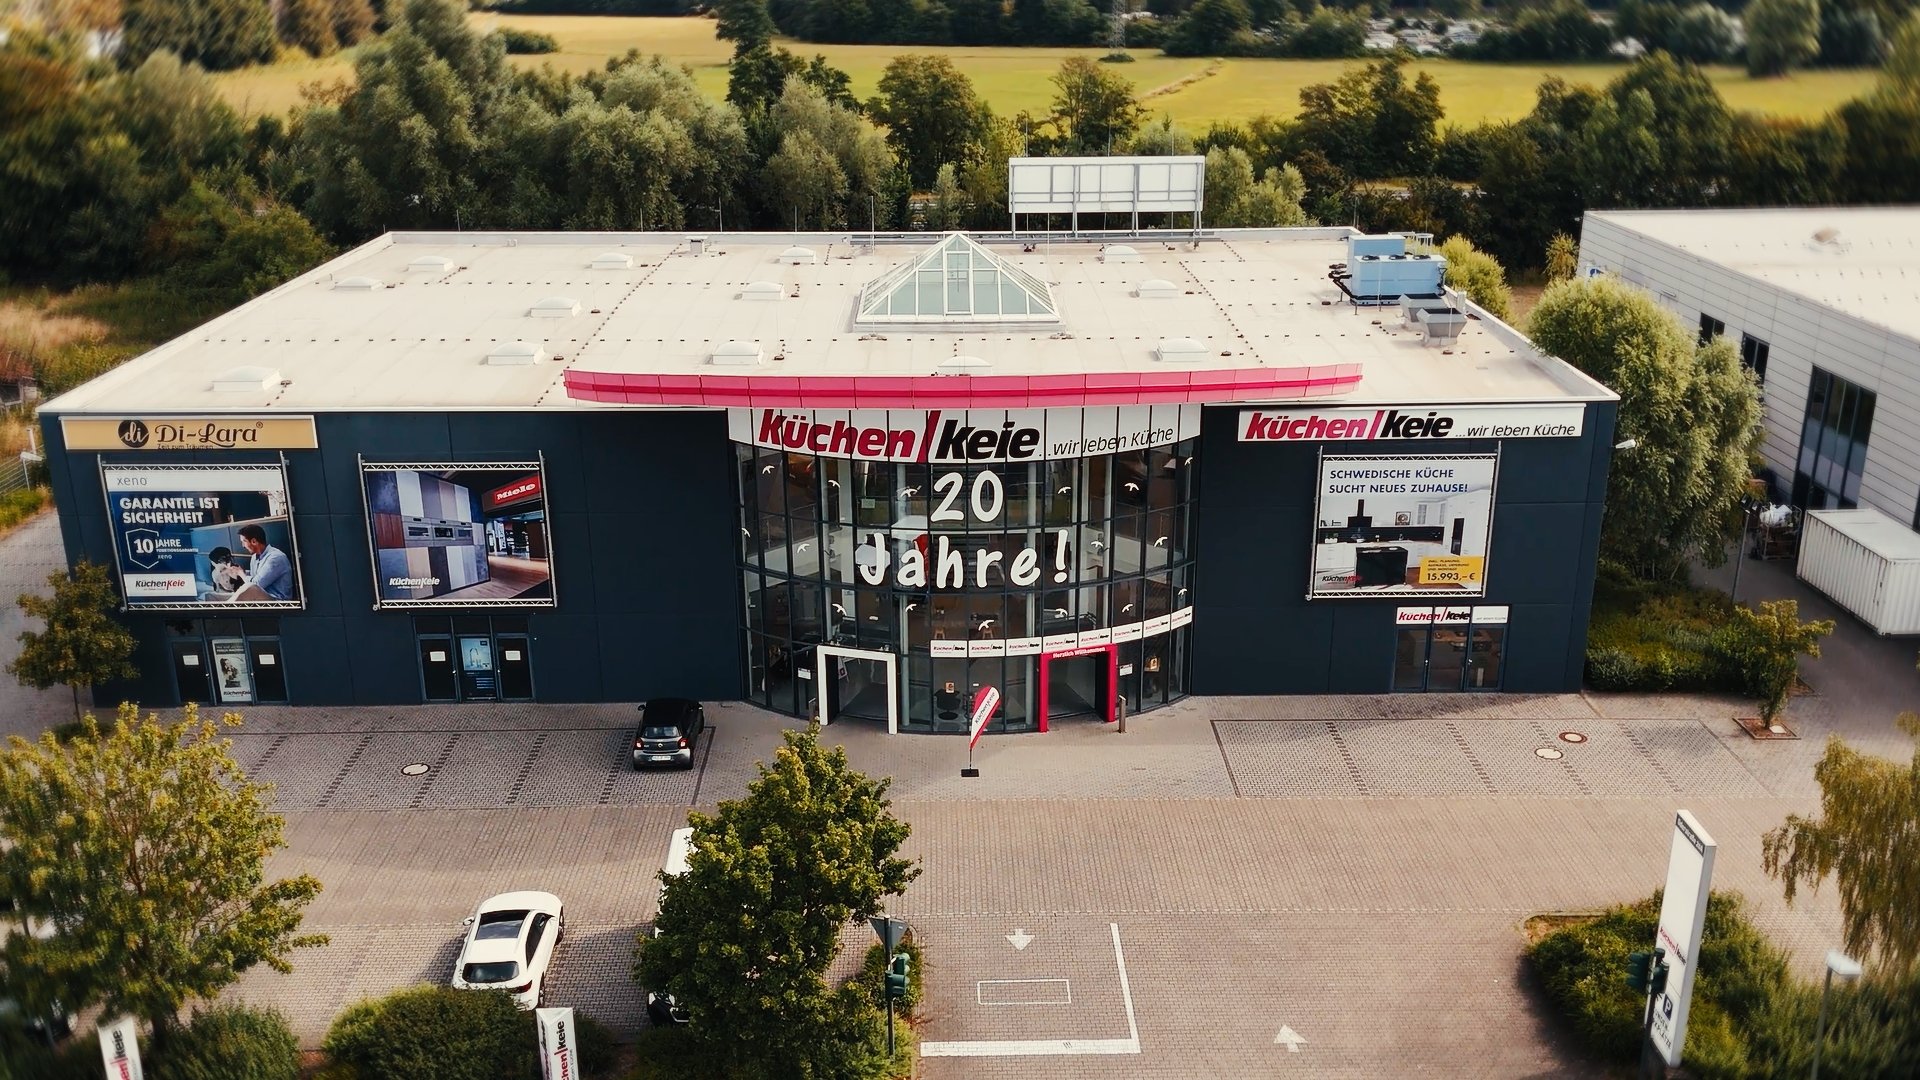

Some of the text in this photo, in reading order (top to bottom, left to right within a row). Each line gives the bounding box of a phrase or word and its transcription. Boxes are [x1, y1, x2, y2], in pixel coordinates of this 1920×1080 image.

[1489, 424, 1531, 437] leben
[1533, 423, 1576, 437] Küche
[1082, 434, 1127, 454] leben
[1131, 427, 1174, 448] Küche
[1329, 466, 1455, 480] SCHWEDISCHE KÜCHE
[116, 475, 148, 487] xeno
[1328, 482, 1469, 494] SUCHT NEUES ZUHAUSE!
[930, 469, 1005, 522] 20
[119, 497, 220, 511] GARANTIE IST
[122, 511, 204, 524] SICHERHEIT
[133, 538, 154, 555] 10
[155, 538, 182, 548] JAHRE
